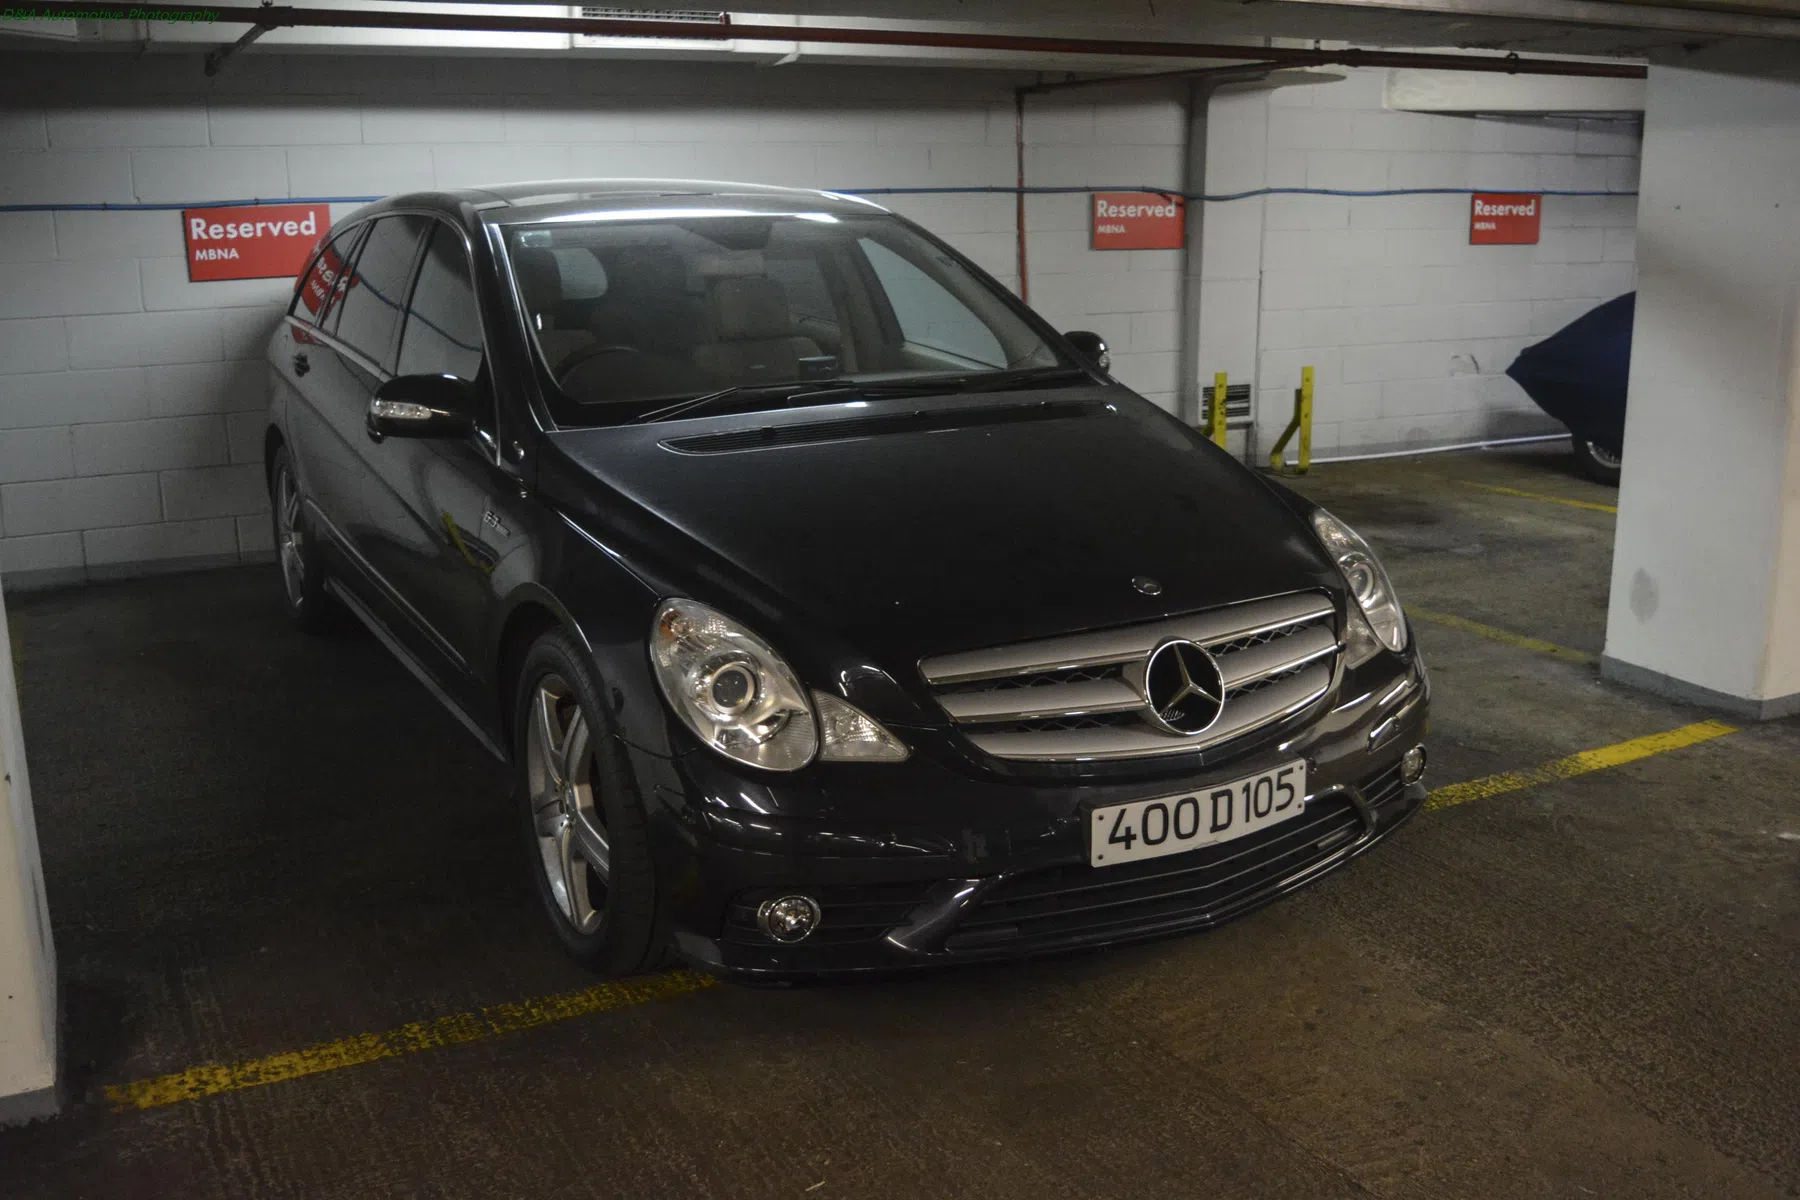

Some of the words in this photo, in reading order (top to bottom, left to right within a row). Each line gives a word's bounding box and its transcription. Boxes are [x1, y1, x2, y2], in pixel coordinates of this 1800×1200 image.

[1097, 199, 1176, 217] Reserved
[1474, 199, 1536, 216] Reserved
[190, 211, 317, 241] Reserved
[1097, 224, 1126, 235] MBNA
[195, 248, 240, 262] MBNA
